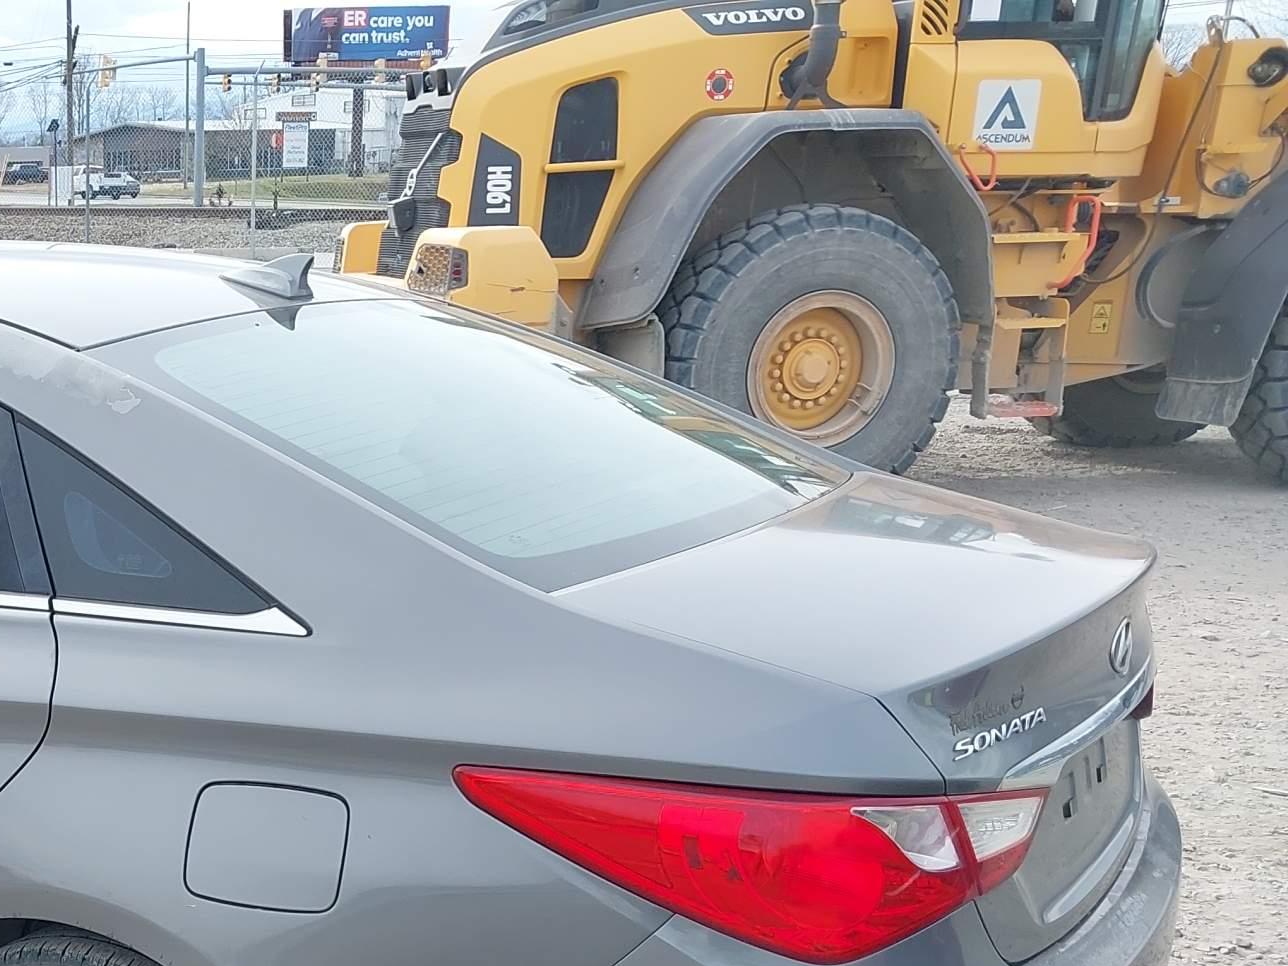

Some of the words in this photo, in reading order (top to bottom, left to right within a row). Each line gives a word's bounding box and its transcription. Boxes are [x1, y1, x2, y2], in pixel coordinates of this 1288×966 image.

[343, 10, 367, 27] ER
[370, 15, 403, 28] care
[406, 15, 434, 30] you
[702, 7, 805, 26] VOLVO
[341, 32, 369, 44] can
[371, 30, 411, 44] trust.
[396, 49, 443, 57] AdventHalth
[975, 133, 1031, 144] ASCENDUM
[485, 166, 513, 214] L90H
[952, 707, 1047, 761] SONATA
